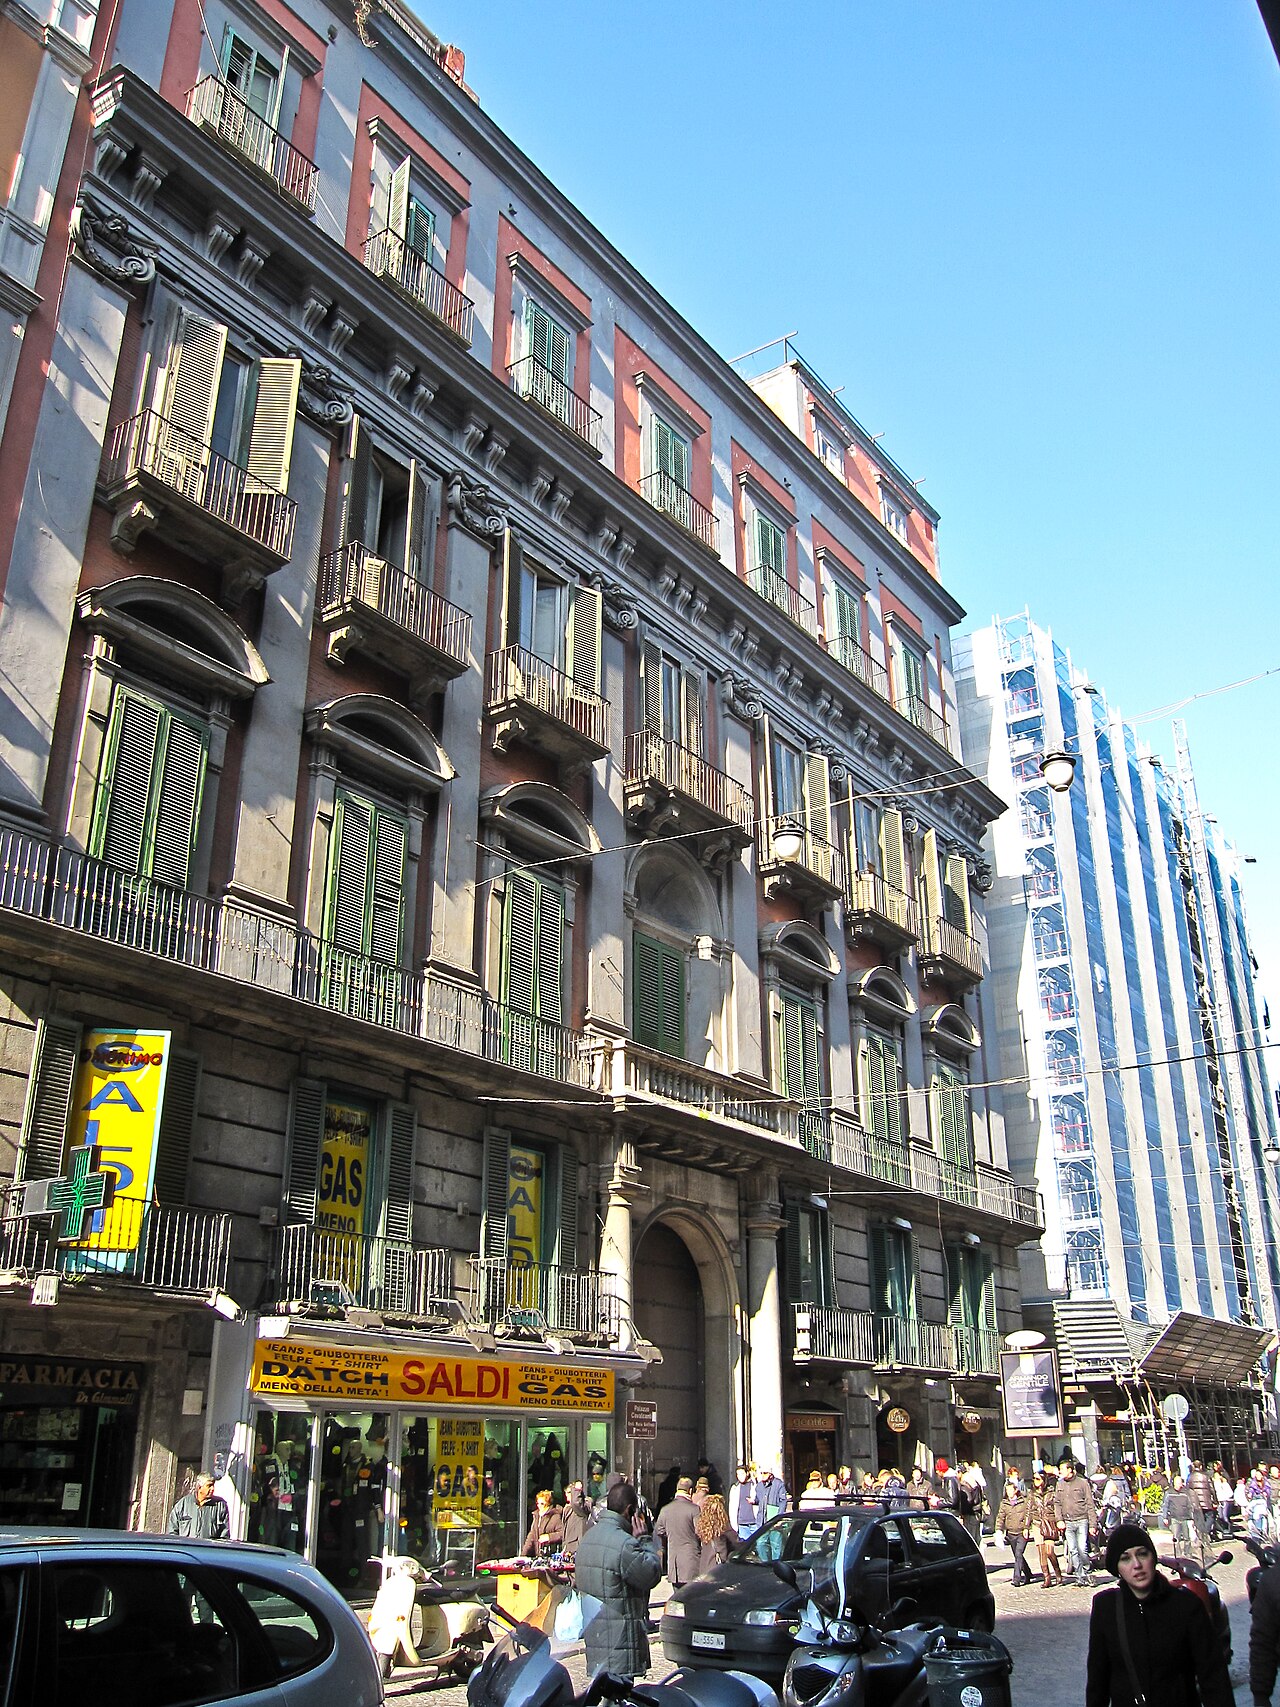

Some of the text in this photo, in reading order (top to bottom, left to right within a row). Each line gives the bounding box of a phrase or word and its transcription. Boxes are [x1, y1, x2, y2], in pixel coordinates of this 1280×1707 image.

[320, 1152, 362, 1207] GAS
[319, 1211, 356, 1233] MENO
[265, 1343, 304, 1355] JEANS
[313, 1349, 389, 1362] GIUBOTTERIA
[274, 1353, 313, 1365] FELPE
[0, 1363, 139, 1390] FARMACIA
[262, 1361, 389, 1386] DATCH
[400, 1360, 510, 1399] SALDI
[519, 1366, 546, 1374] JEANS
[554, 1369, 607, 1378] GIUBOTTERIA
[525, 1374, 555, 1382] FELPE
[260, 1382, 300, 1391] MENO
[303, 1384, 344, 1394] DELLA
[347, 1387, 382, 1397] META'
[518, 1381, 607, 1398] GAS
[1009, 1380, 1050, 1389] GENTILE
[520, 1397, 548, 1405] MENO
[550, 1399, 579, 1407] DELLA
